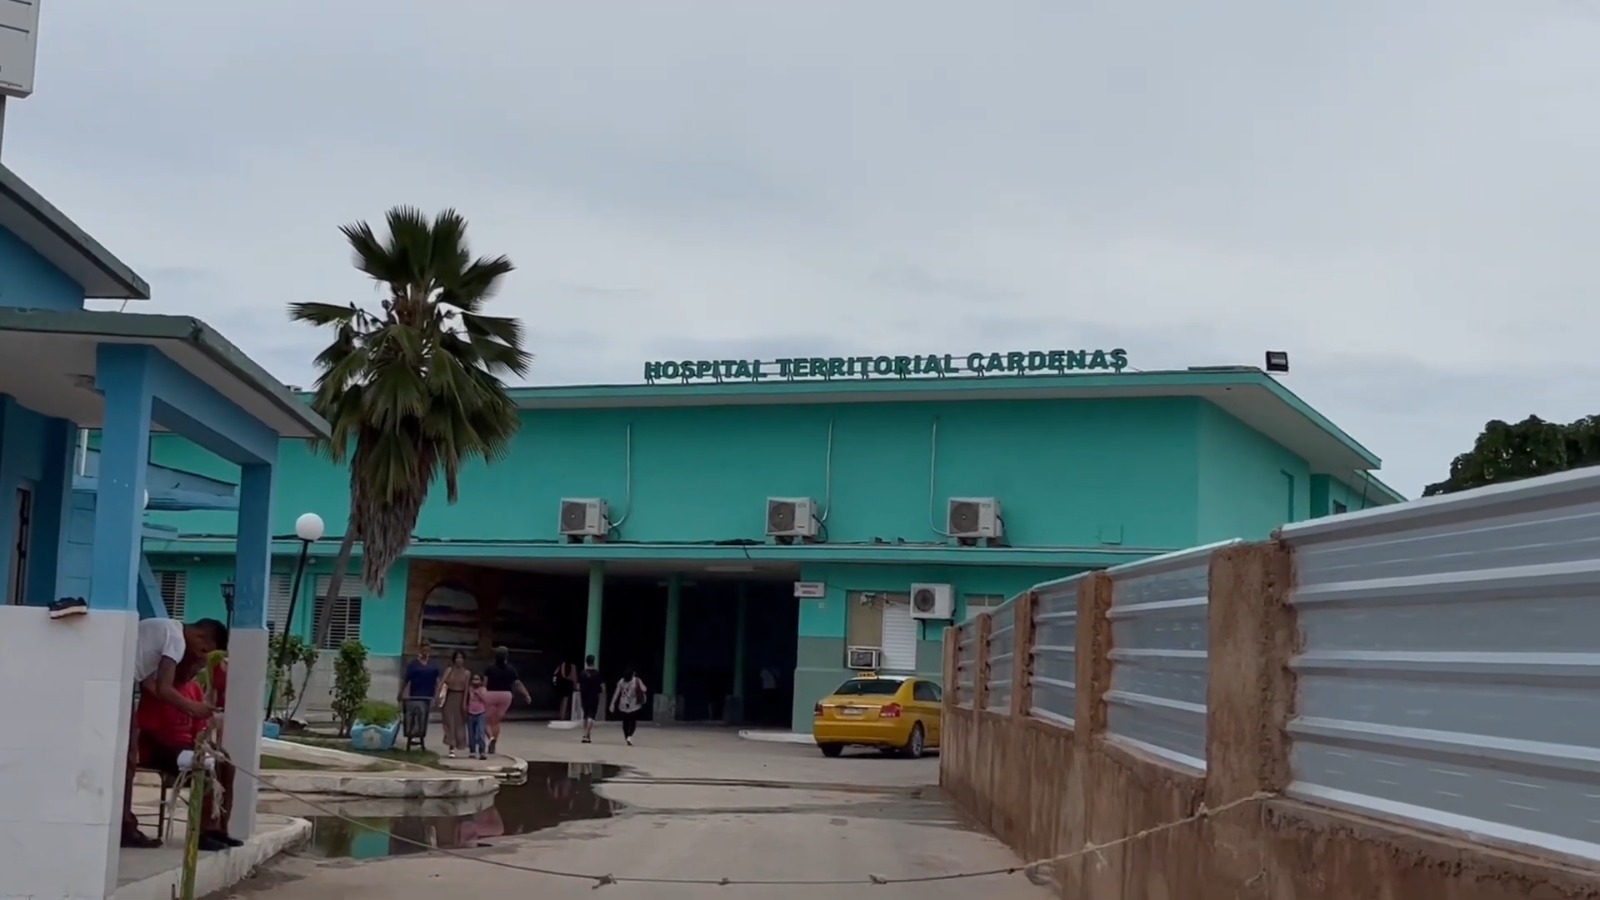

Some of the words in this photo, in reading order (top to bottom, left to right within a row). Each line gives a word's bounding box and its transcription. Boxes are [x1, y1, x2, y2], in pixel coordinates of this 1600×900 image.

[644, 359, 767, 380] HOSPITAL
[775, 354, 959, 377] TERRITORIAL
[966, 348, 1128, 372] CARDENAS
